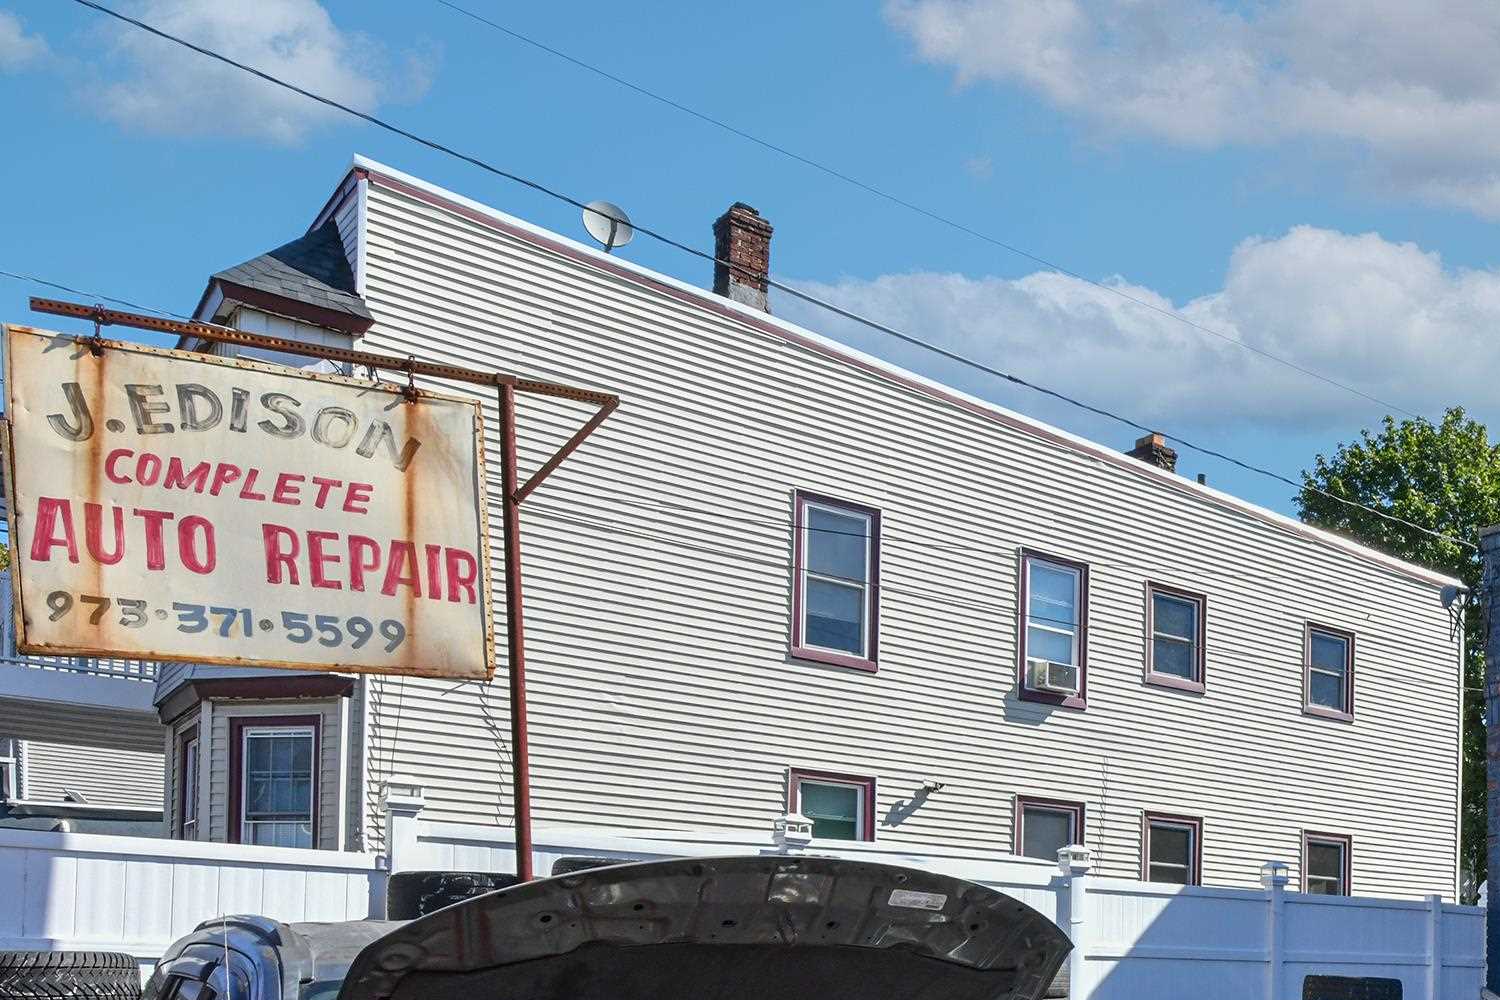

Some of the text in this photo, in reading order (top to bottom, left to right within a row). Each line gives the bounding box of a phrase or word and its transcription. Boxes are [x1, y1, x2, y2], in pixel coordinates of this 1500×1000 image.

[105, 448, 374, 515] COMPLETE
[30, 496, 478, 605] AUTO REPAIR
